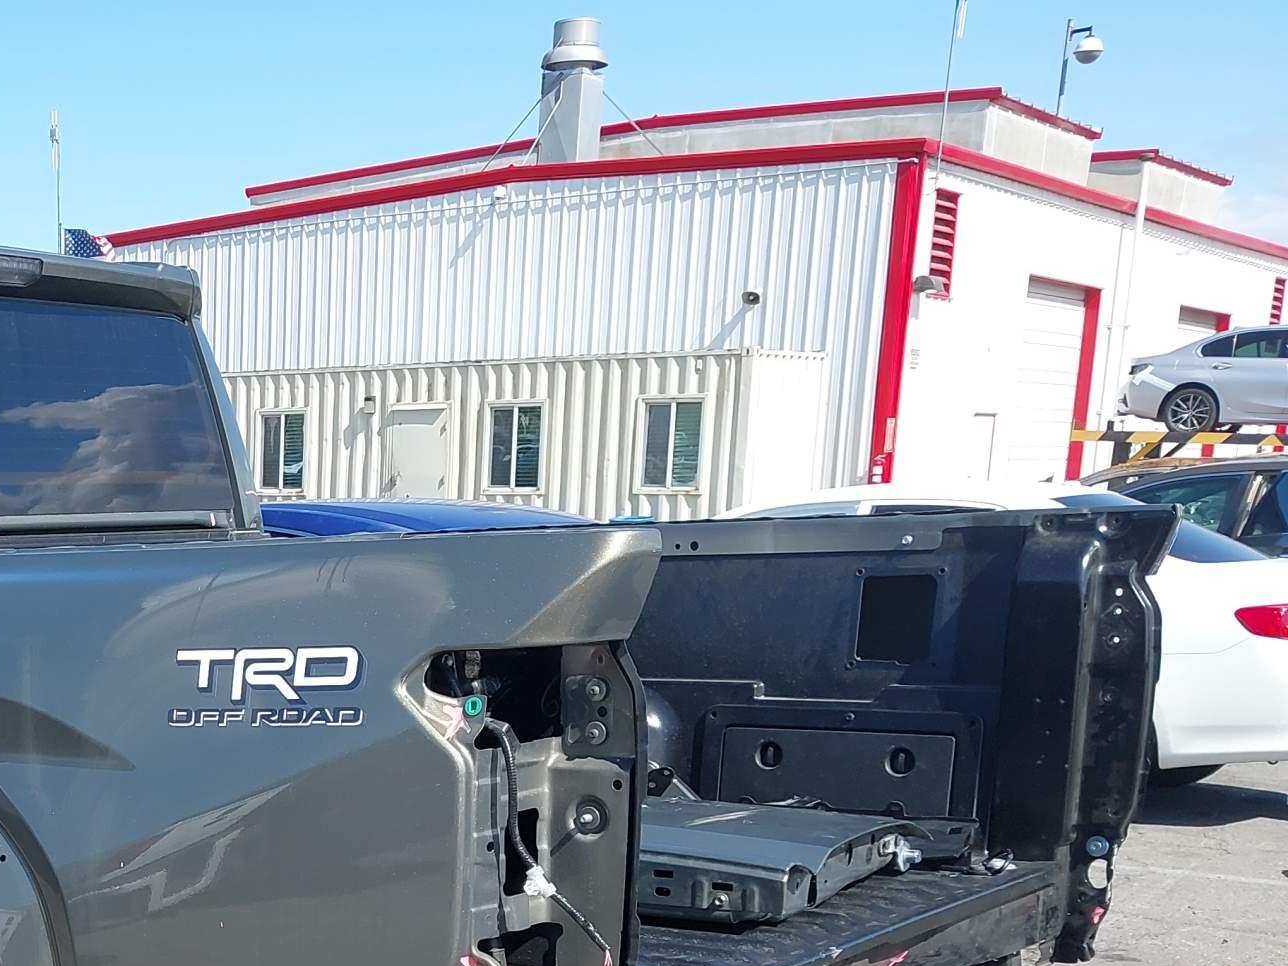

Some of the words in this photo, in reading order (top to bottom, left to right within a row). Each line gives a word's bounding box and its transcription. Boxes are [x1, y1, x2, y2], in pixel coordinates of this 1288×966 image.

[176, 646, 367, 705] TRD
[168, 707, 245, 727] OFF
[251, 706, 365, 727] ROAD
